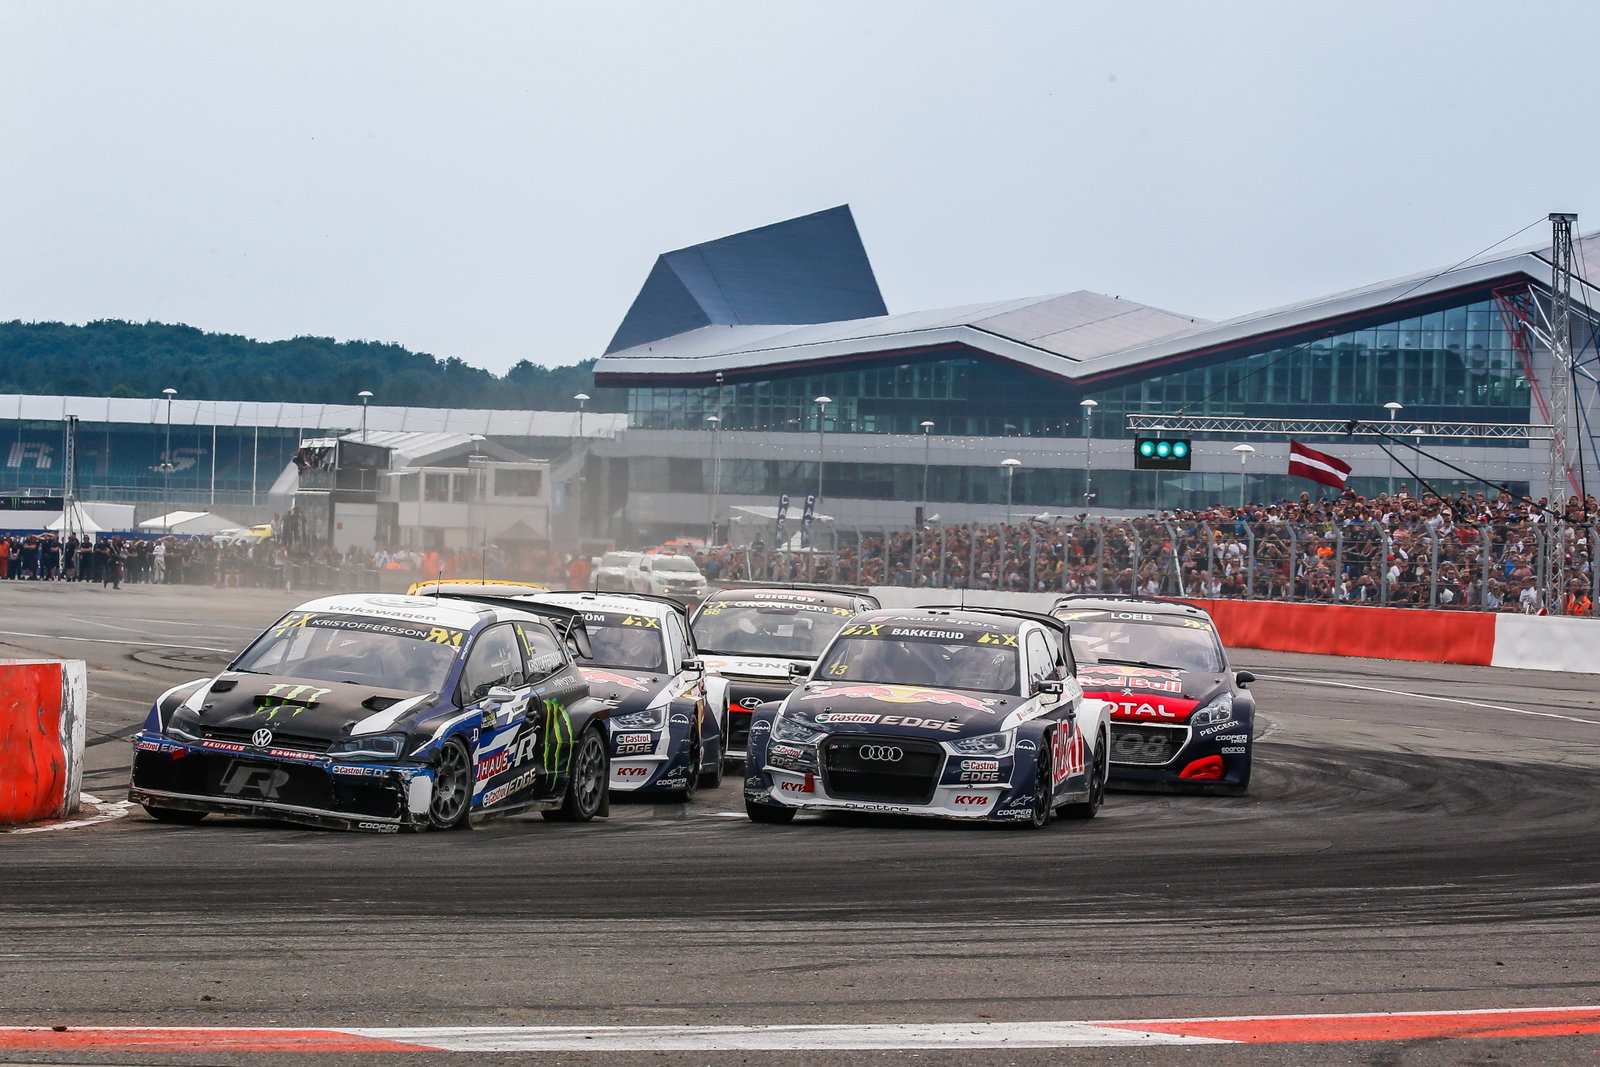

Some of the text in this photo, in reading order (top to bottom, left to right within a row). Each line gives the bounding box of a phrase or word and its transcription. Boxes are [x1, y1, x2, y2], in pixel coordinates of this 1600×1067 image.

[328, 605, 437, 621] Volkswagen
[1110, 613, 1153, 622] LOEB
[312, 619, 427, 638] KRISTOFFERSSON
[948, 618, 1001, 630] Sport
[891, 628, 964, 640] BAKKERUD
[828, 664, 848, 676] 13
[1129, 678, 1182, 693] Bull
[829, 713, 965, 733] Castrol EDGE
[1199, 720, 1240, 736] PEUGEOT
[625, 735, 650, 743] Castrol
[203, 741, 245, 751] BAUHAUS
[616, 744, 653, 755] EDGE
[1221, 746, 1246, 754] sparco
[271, 749, 316, 760] BAUHAUS
[779, 747, 803, 758] Castrol
[340, 767, 363, 775] Castrol
[477, 752, 510, 780] HAUS
[970, 761, 997, 771] Castrol
[616, 767, 648, 776] KYB
[507, 769, 537, 795] EDGE
[656, 777, 687, 786] COOPER
[960, 772, 1000, 782] EDGE
[954, 795, 989, 805] KYB
[845, 803, 910, 812] quattro
[997, 808, 1033, 817] COOPER
[358, 822, 400, 831] COOPER
